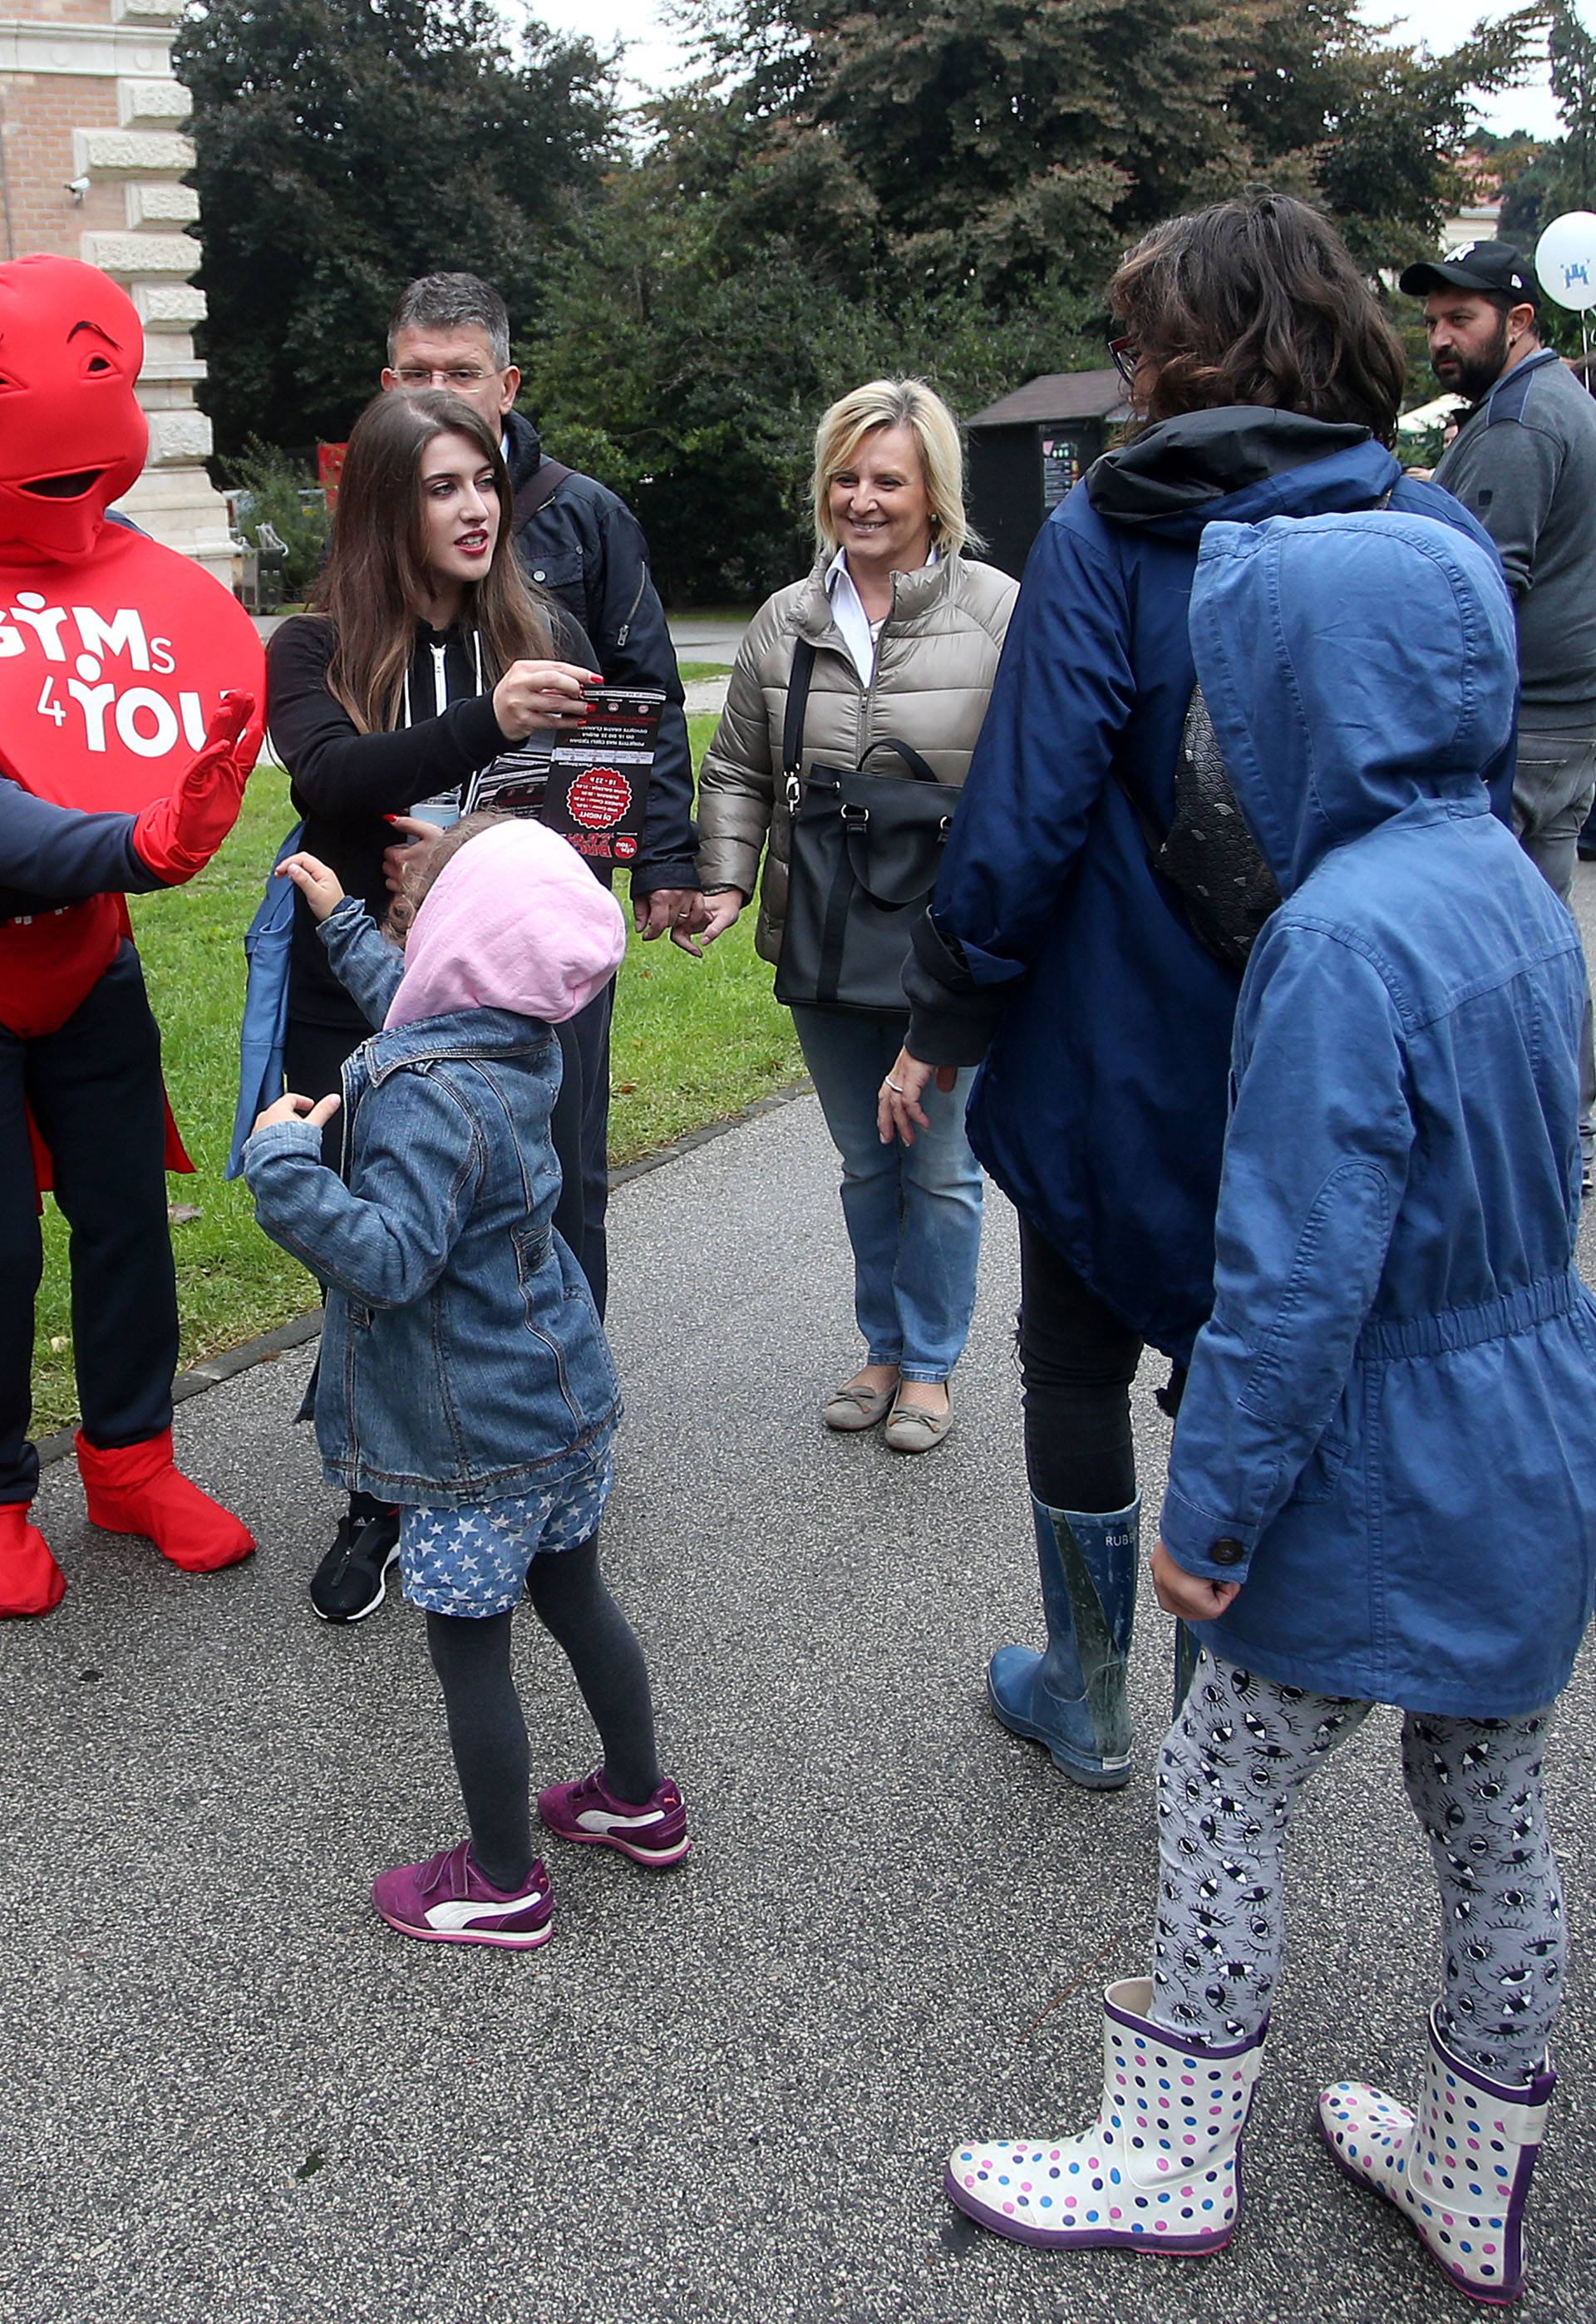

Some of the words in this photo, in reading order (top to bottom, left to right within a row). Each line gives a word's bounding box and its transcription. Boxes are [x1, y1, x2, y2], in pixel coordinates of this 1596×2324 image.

[37, 675, 66, 726] 4
[579, 811, 603, 820] NIGHT
[603, 813, 612, 821] DJ
